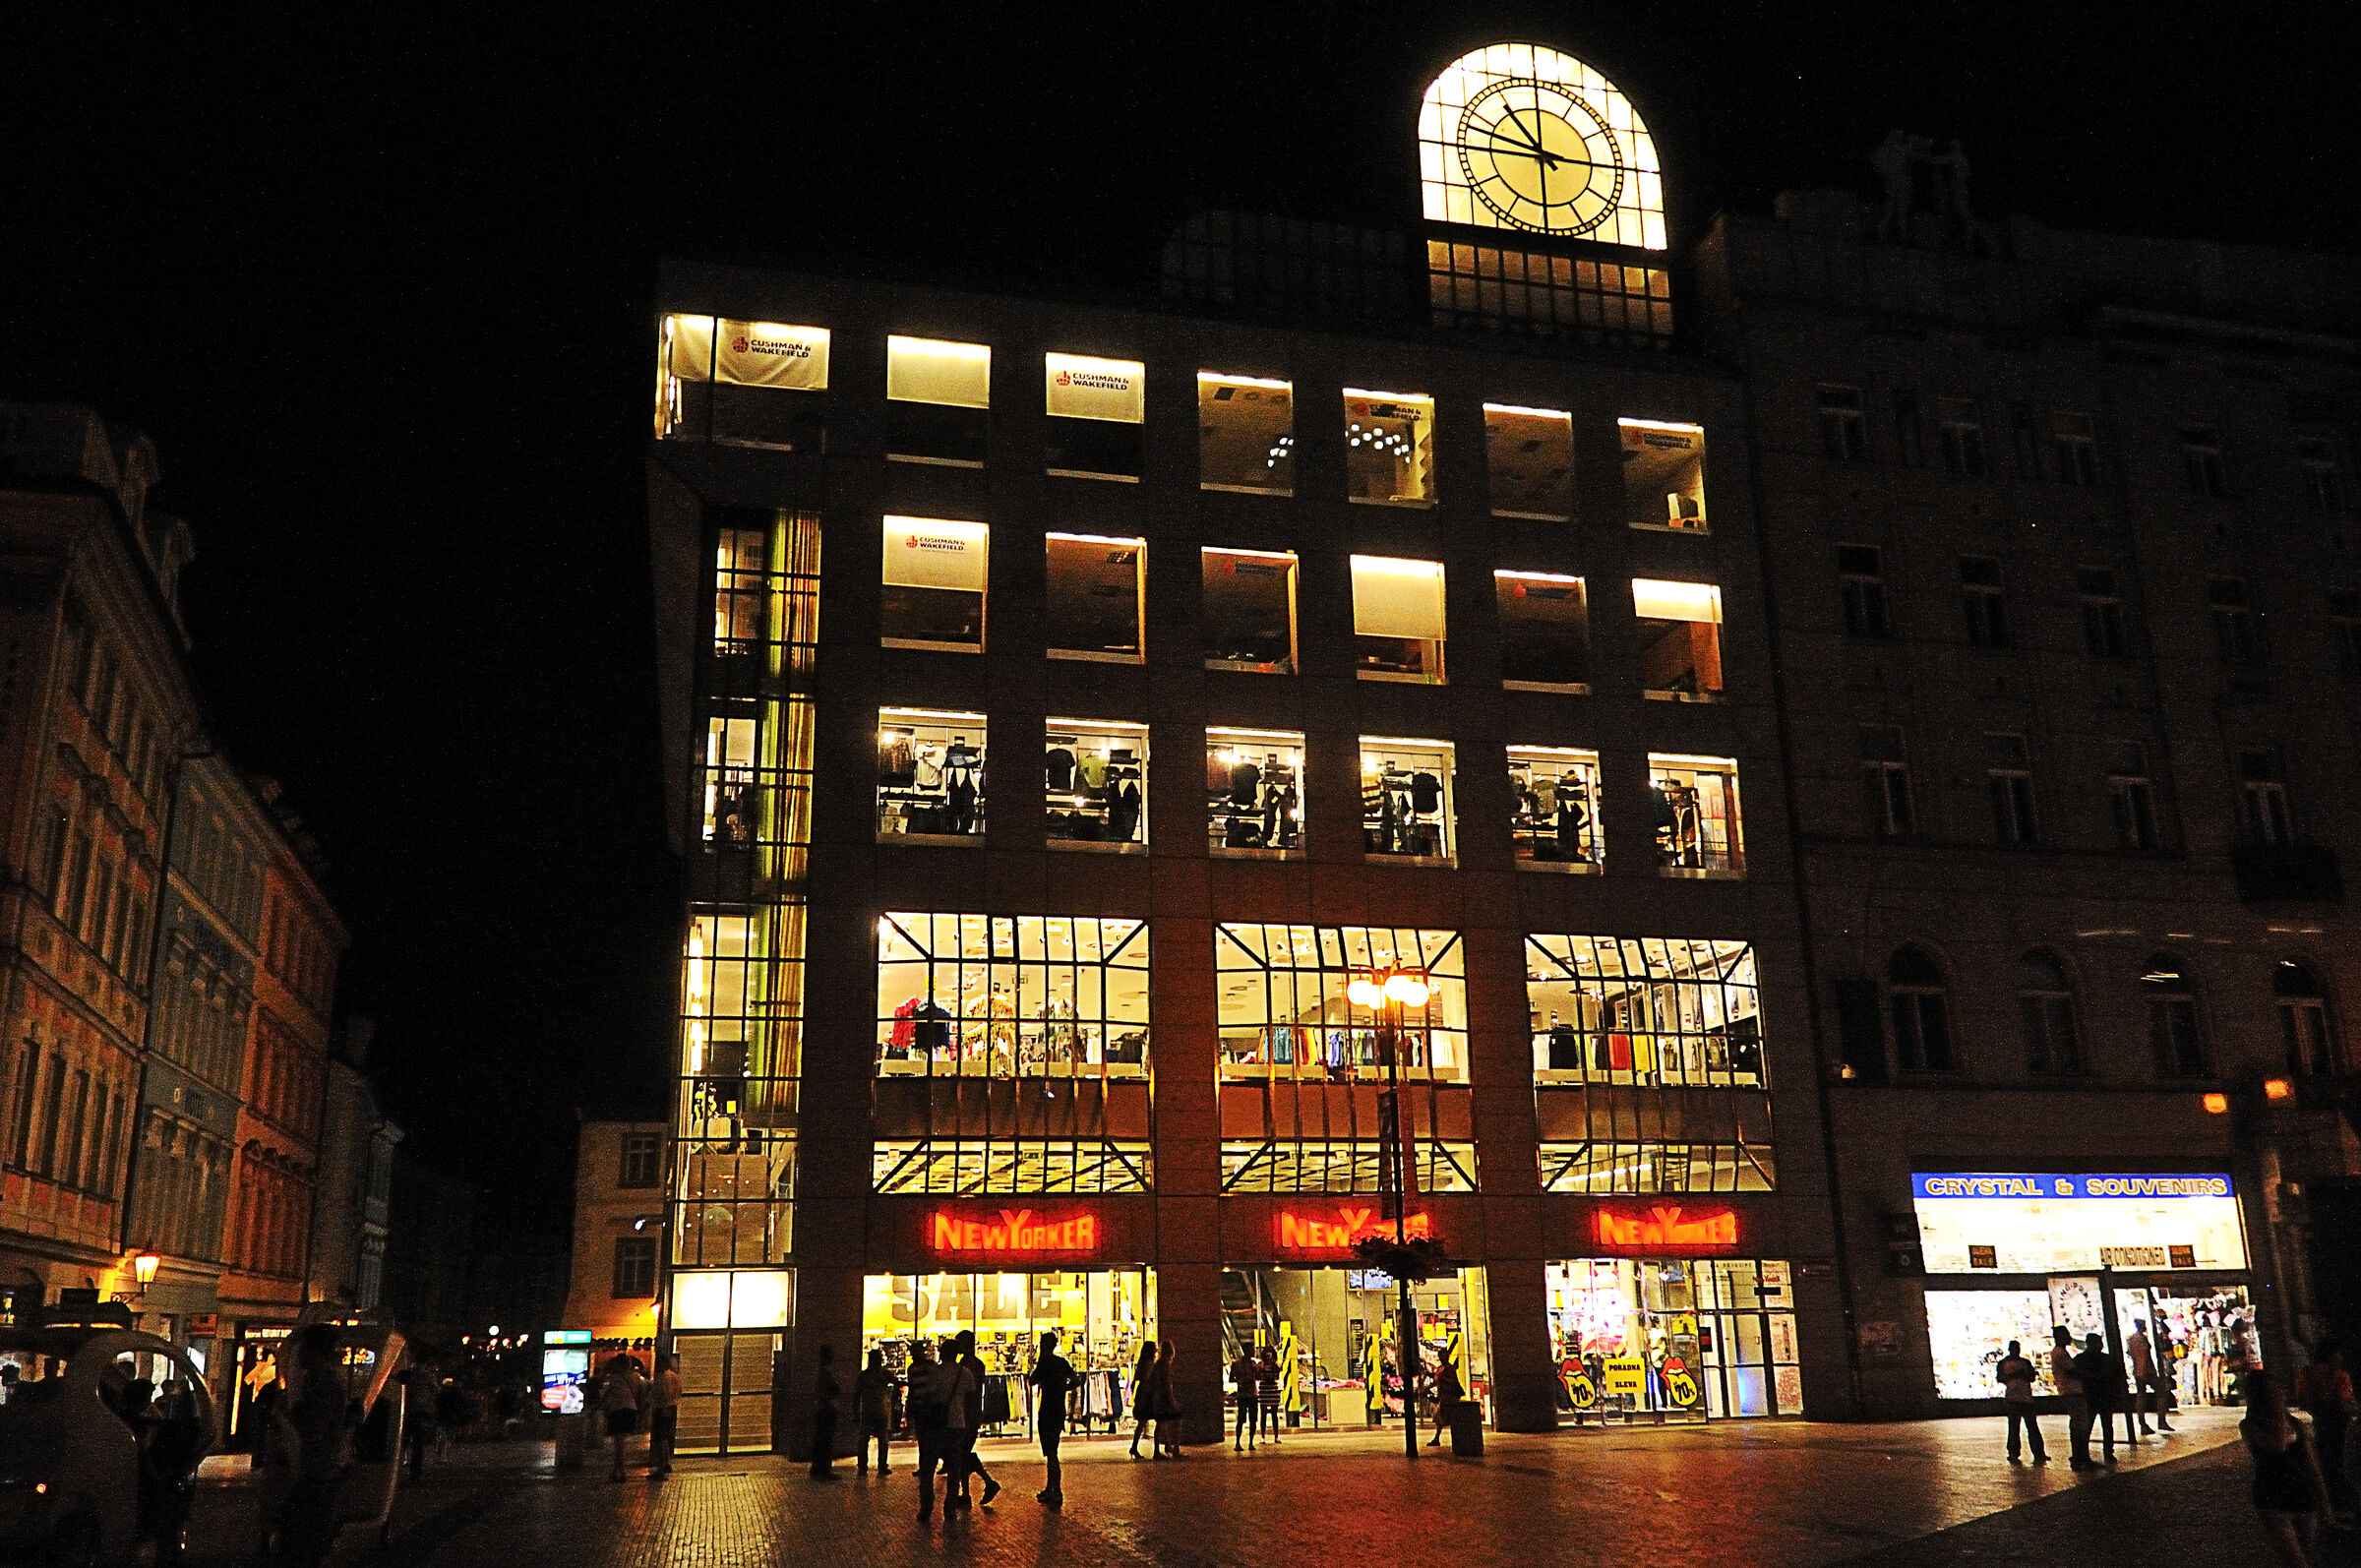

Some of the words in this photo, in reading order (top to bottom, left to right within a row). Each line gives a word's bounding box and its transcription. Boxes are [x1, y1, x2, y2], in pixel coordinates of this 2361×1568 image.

[751, 339, 803, 350] CUSHMAN
[751, 346, 810, 358] WAKEFIELD
[1073, 373, 1121, 383] CUSHMAN
[1073, 380, 1127, 390] WAKEFIELD
[1925, 1177, 2044, 1196] CRYSTAL
[2055, 1177, 2074, 1196] &
[2086, 1177, 2227, 1196] SOUVENIRS
[892, 1274, 1061, 1322] SALE
